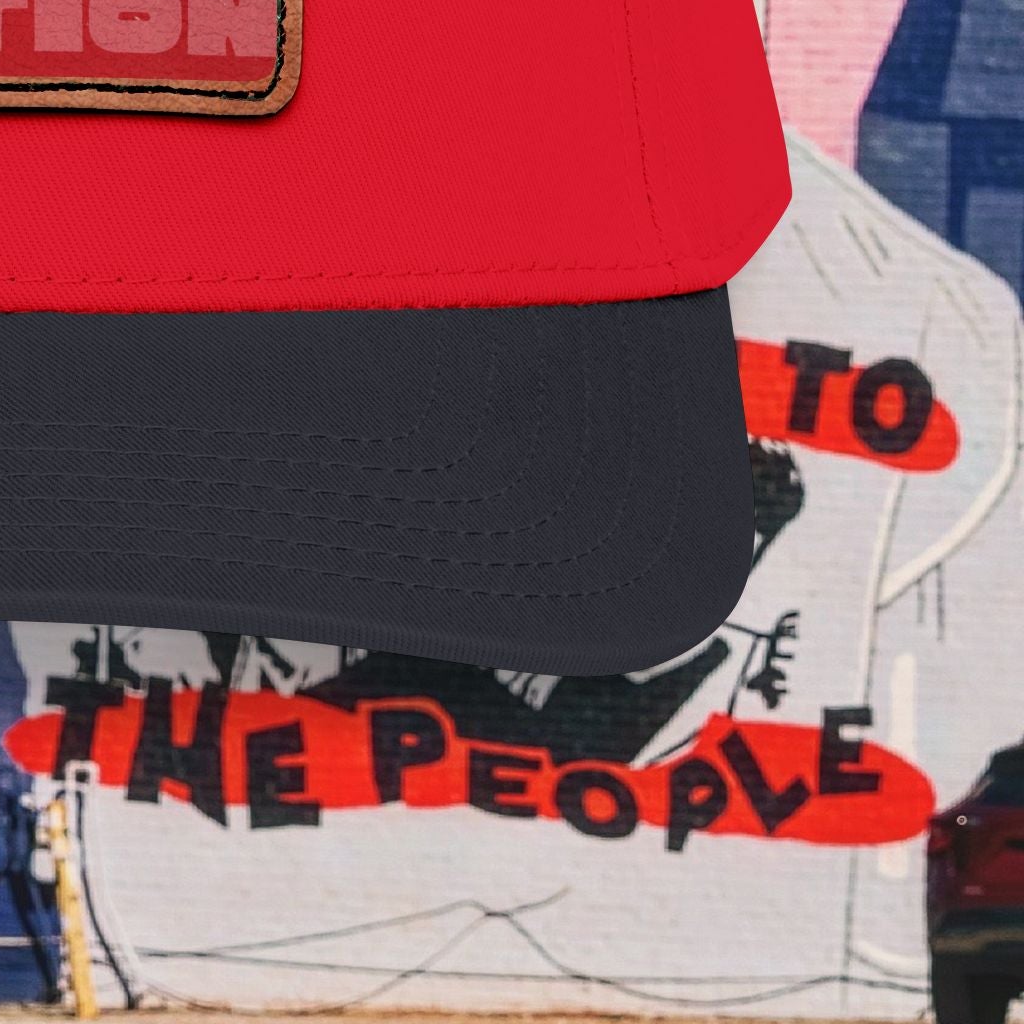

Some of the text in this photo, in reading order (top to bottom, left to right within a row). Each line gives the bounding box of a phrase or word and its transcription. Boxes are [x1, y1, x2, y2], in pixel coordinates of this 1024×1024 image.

[786, 338, 933, 454] TO
[45, 676, 881, 852] THE PEOPLE
